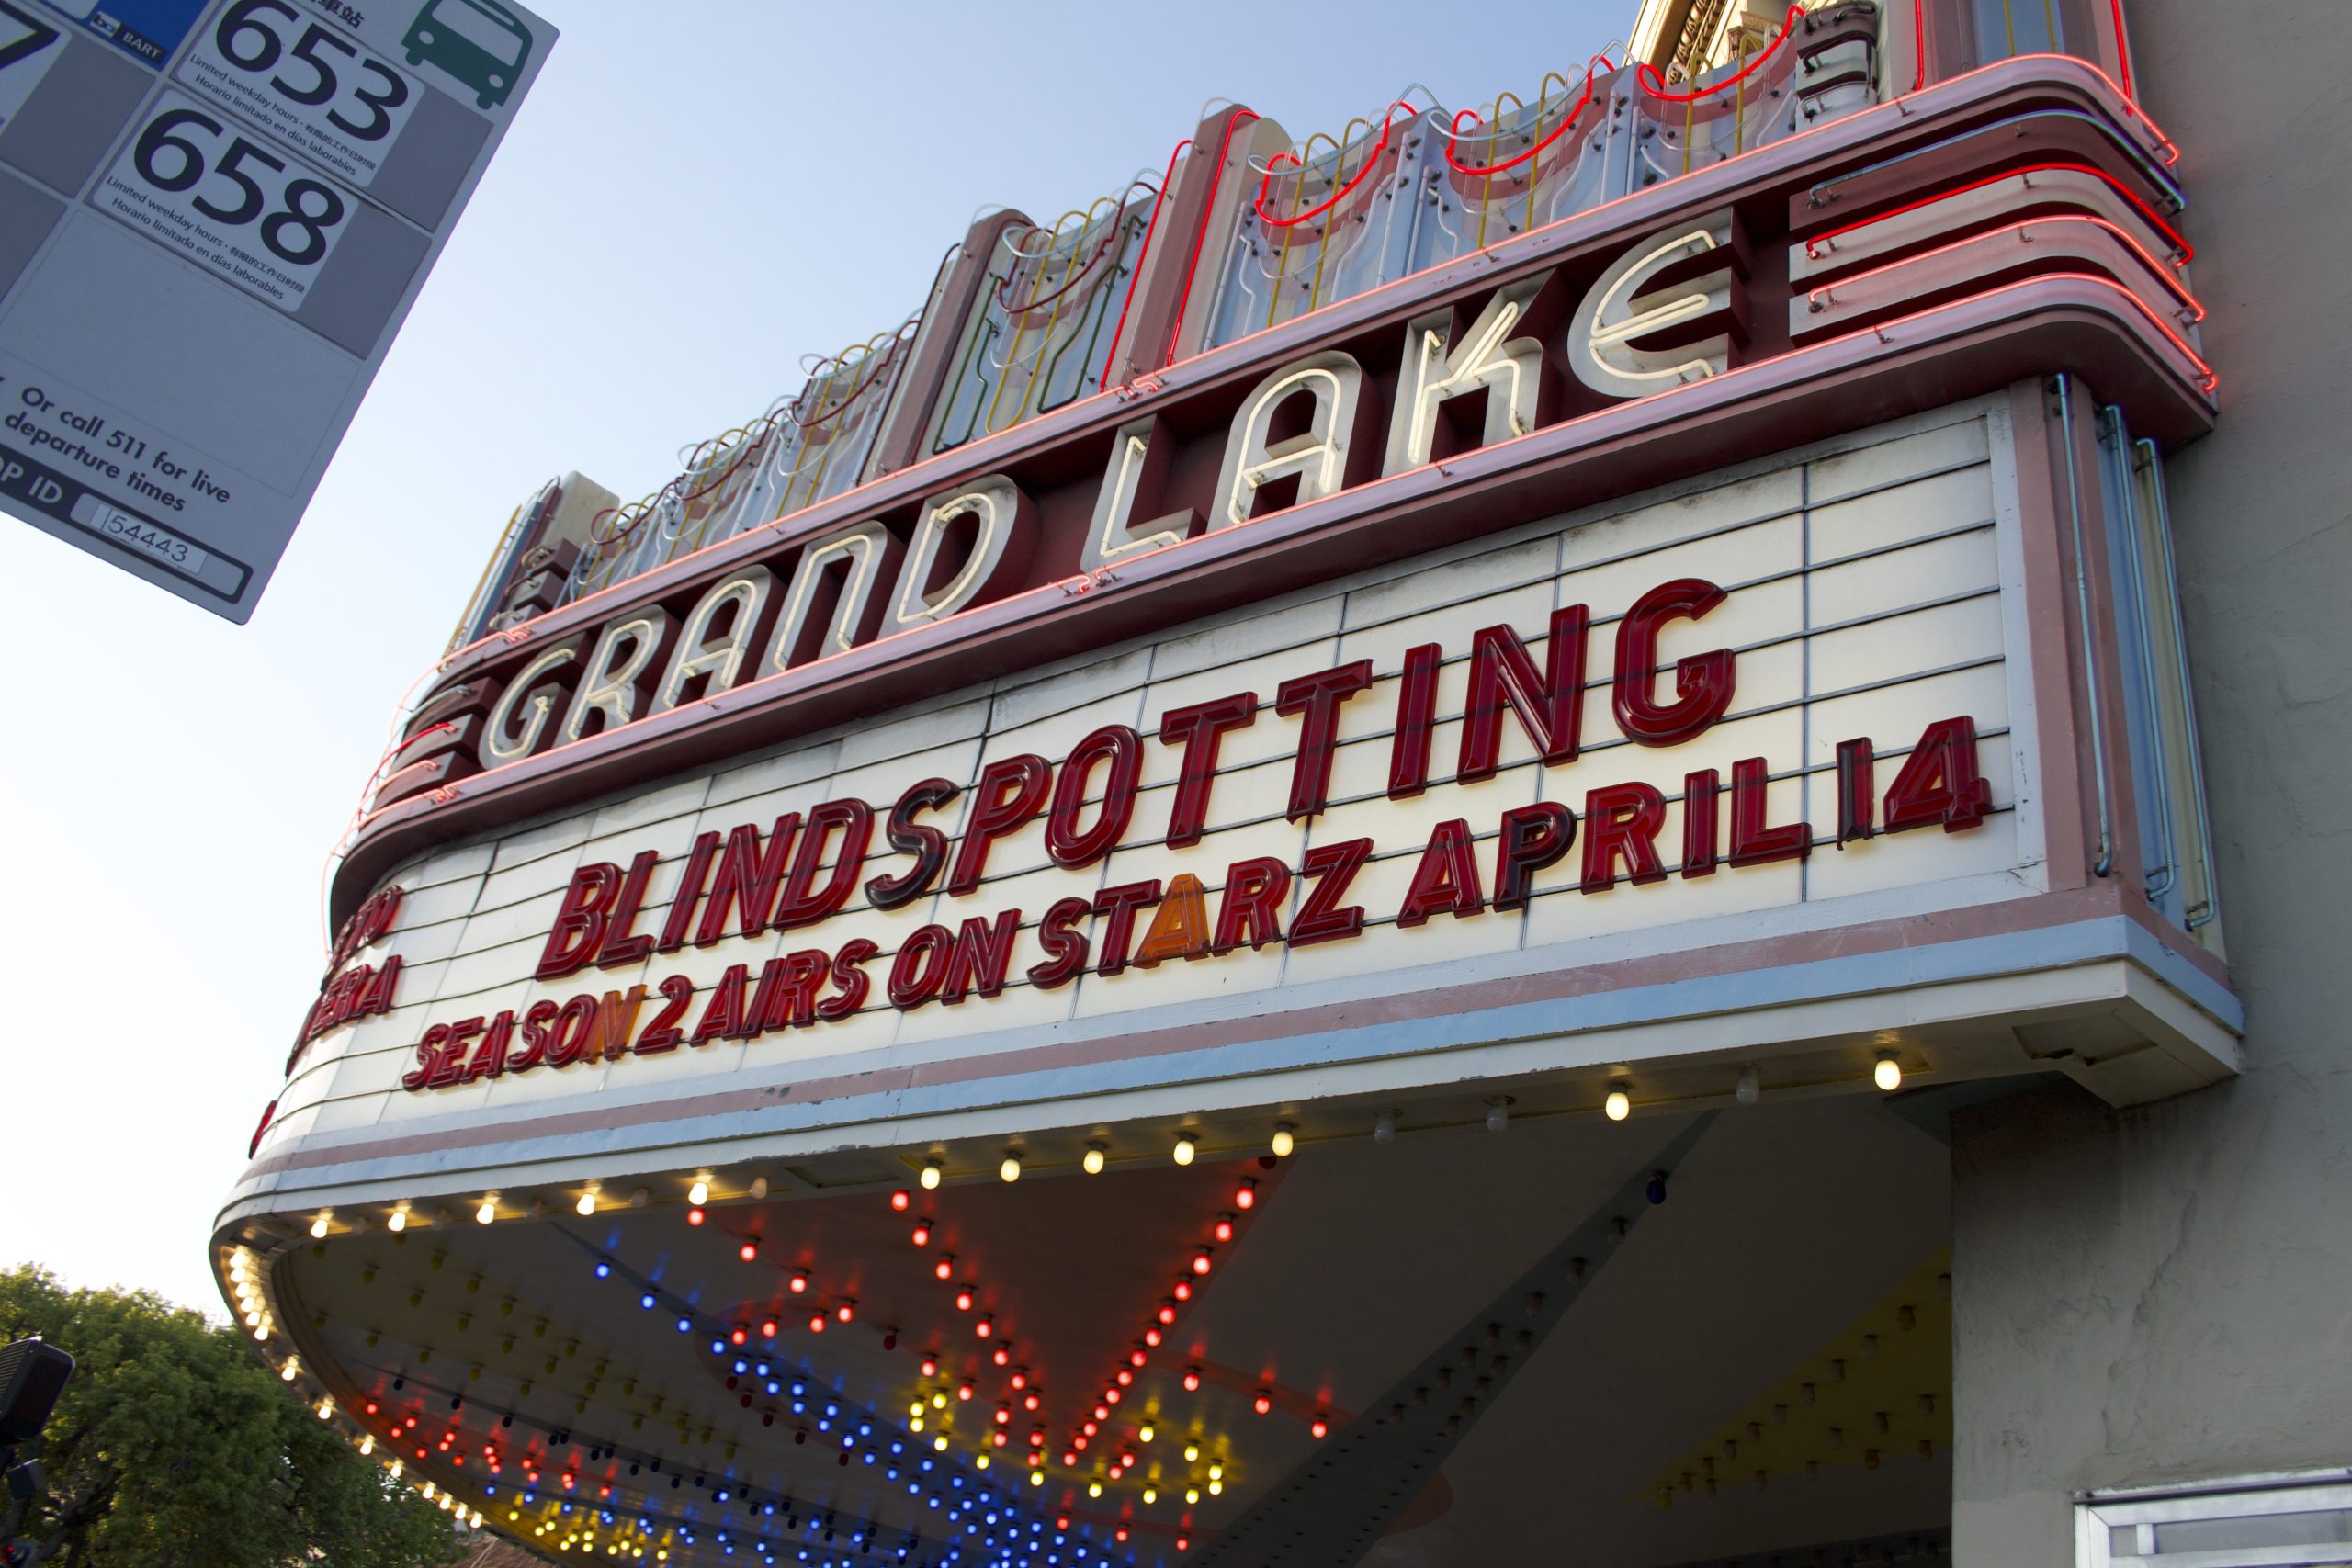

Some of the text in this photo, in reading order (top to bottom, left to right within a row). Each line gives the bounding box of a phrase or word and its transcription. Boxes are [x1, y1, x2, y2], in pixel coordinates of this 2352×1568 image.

[122, 32, 161, 58] BART
[190, 53, 299, 124] Limited weekday hours
[216, 0, 408, 141] 653
[195, 74, 356, 175] Horario limitado en días laborables
[107, 176, 222, 247] Limited weekday hours
[134, 109, 345, 265] 658
[112, 197, 284, 299] Horario limitado en días laborables
[0, 456, 62, 503] P ID
[5, 412, 186, 512] departure times
[21, 387, 230, 503] Or call 511 for live
[478, 206, 1735, 770] GRAND LAKE
[107, 514, 188, 563] 54443
[536, 578, 1736, 981] BLINDSPOTTING
[402, 716, 1992, 1091] SEASON 2 AIRS ON STARZ APRIL 14
